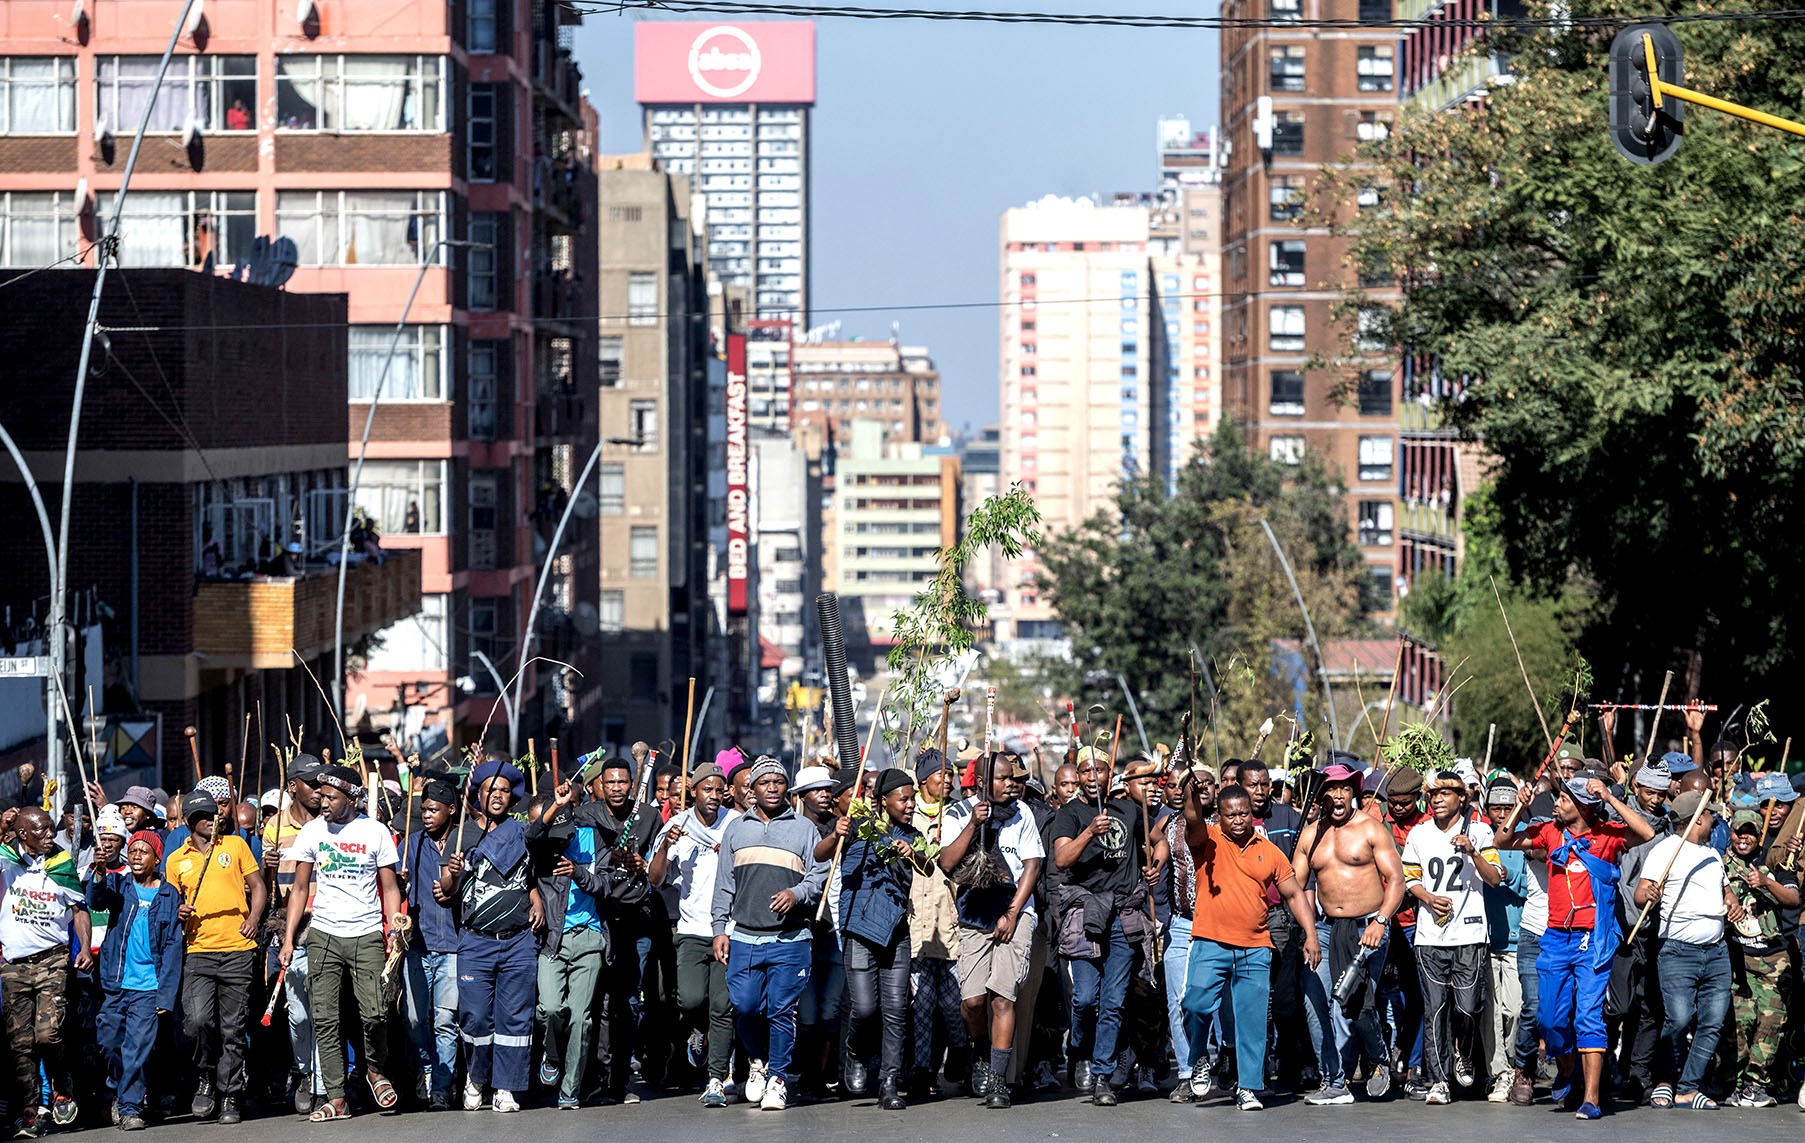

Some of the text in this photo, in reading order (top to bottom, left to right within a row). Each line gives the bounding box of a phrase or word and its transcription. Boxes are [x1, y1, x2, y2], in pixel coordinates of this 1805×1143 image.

[727, 371, 747, 579] BED AND BREAKFAST
[319, 842, 366, 854] MARCH
[1428, 856, 1464, 892] 92
[9, 885, 57, 902] MARCH
[18, 898, 47, 910] AND
